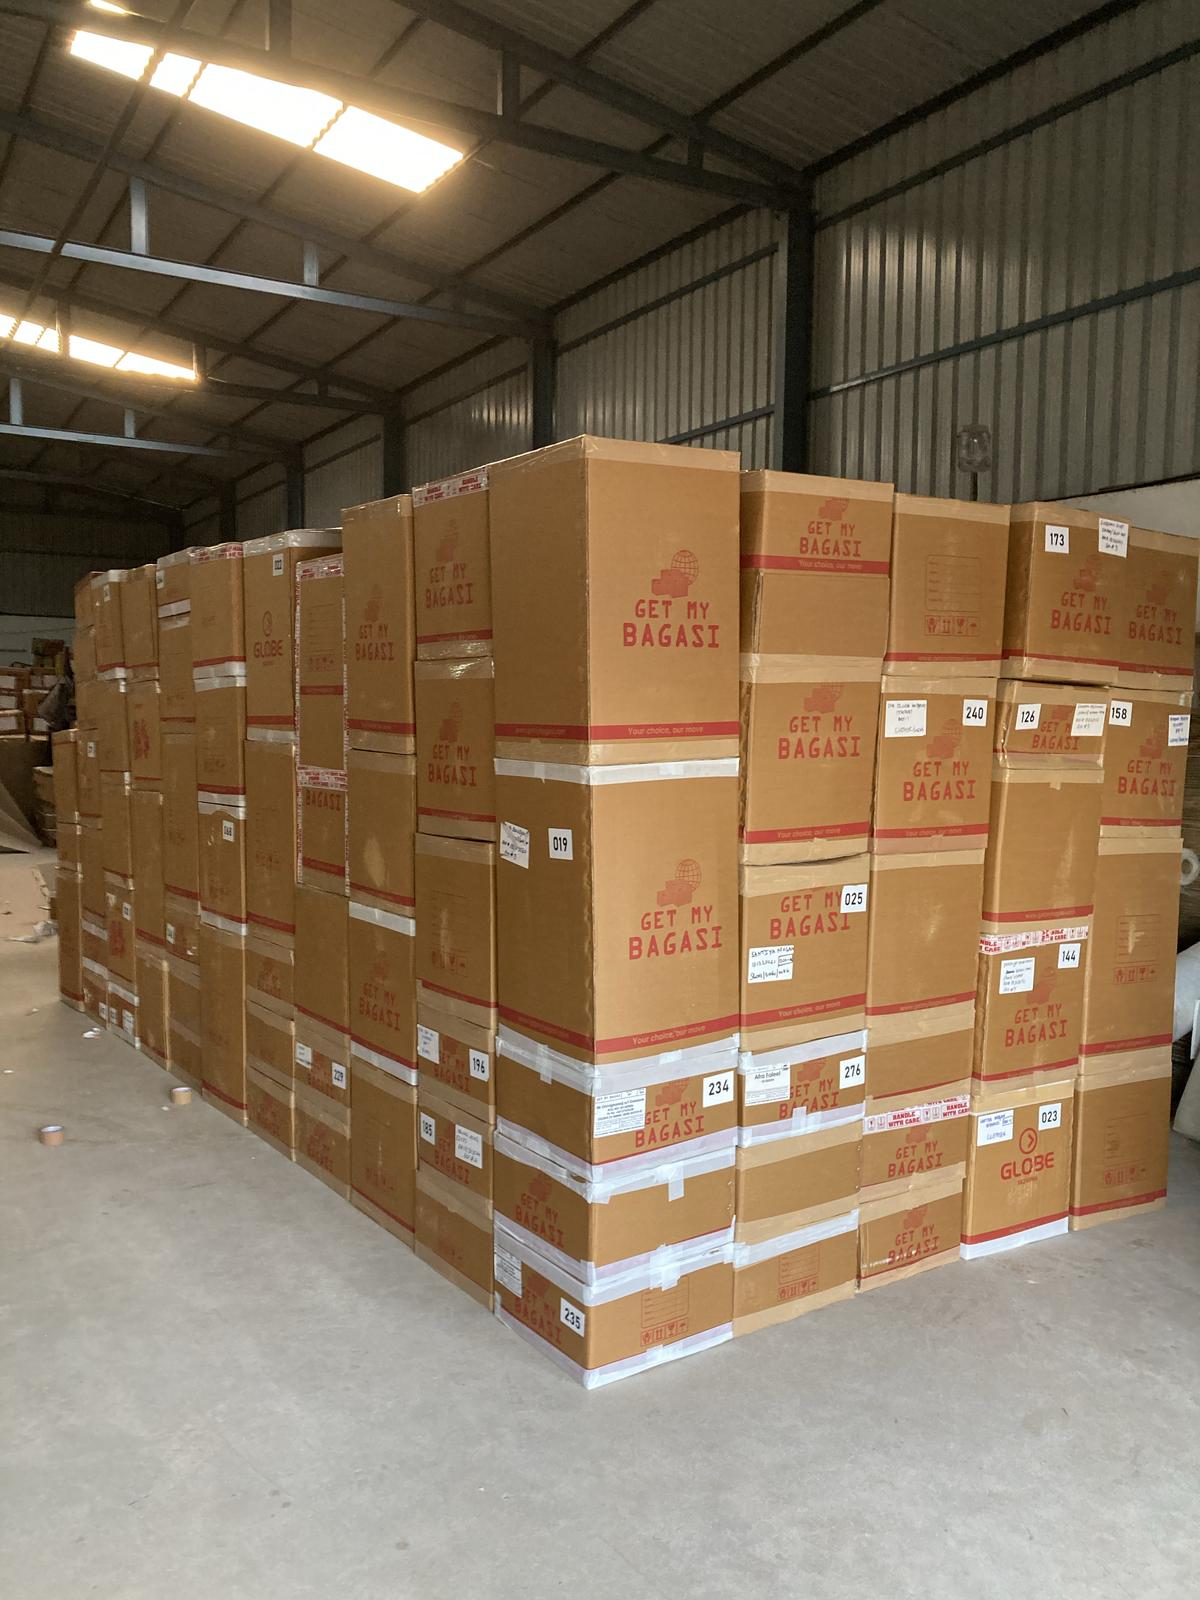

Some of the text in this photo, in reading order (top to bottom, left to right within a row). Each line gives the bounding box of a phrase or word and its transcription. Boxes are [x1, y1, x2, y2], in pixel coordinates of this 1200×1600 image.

[808, 521, 855, 537] GET MY
[800, 537, 861, 557] BAGASI
[1050, 533, 1065, 547] 173
[635, 599, 710, 619] GET MY
[1061, 592, 1107, 610] GET MY
[1051, 609, 1112, 635] BAGASI
[1137, 605, 1177, 622] GET MY
[623, 623, 719, 648] BAGASI
[1129, 621, 1183, 645] BAGASI
[966, 707, 984, 719] 240
[1021, 711, 1035, 723] 126
[1111, 707, 1127, 720] 158
[628, 727, 645, 736] Your
[789, 715, 853, 733] GET MY
[1040, 722, 1059, 733] GET
[778, 736, 861, 760] BAGASI
[1032, 735, 1079, 750] BAGASI
[428, 763, 477, 787] BAGASI
[913, 761, 970, 777] GET MY
[1127, 760, 1173, 776] GET MY
[903, 780, 976, 802] BAGASI
[1118, 776, 1177, 797] BAGASI
[553, 836, 568, 852] 019
[781, 892, 841, 913] GET MY
[844, 892, 863, 906] 025
[641, 905, 712, 931] GET MY
[770, 912, 850, 940] BAGASI
[628, 926, 722, 960] BAGASI
[1062, 950, 1076, 962] 144
[1015, 1003, 1063, 1025] GET MY
[633, 1036, 650, 1045] Your
[1005, 1019, 1068, 1048] BAGASI
[473, 1057, 485, 1074] 196
[844, 1063, 861, 1079] 276
[708, 1080, 729, 1096] 234
[819, 1079, 833, 1094] MY
[645, 1101, 696, 1125] GET MY
[1042, 1110, 1057, 1123] 023
[635, 1115, 704, 1148] BAGASI
[896, 1140, 938, 1159] GET MY
[888, 1152, 943, 1178] BAGASI
[1001, 1152, 1055, 1180] GLOBE
[895, 1224, 934, 1246] GET MY
[888, 1236, 939, 1265] BAGASI
[565, 1307, 581, 1330] 235
